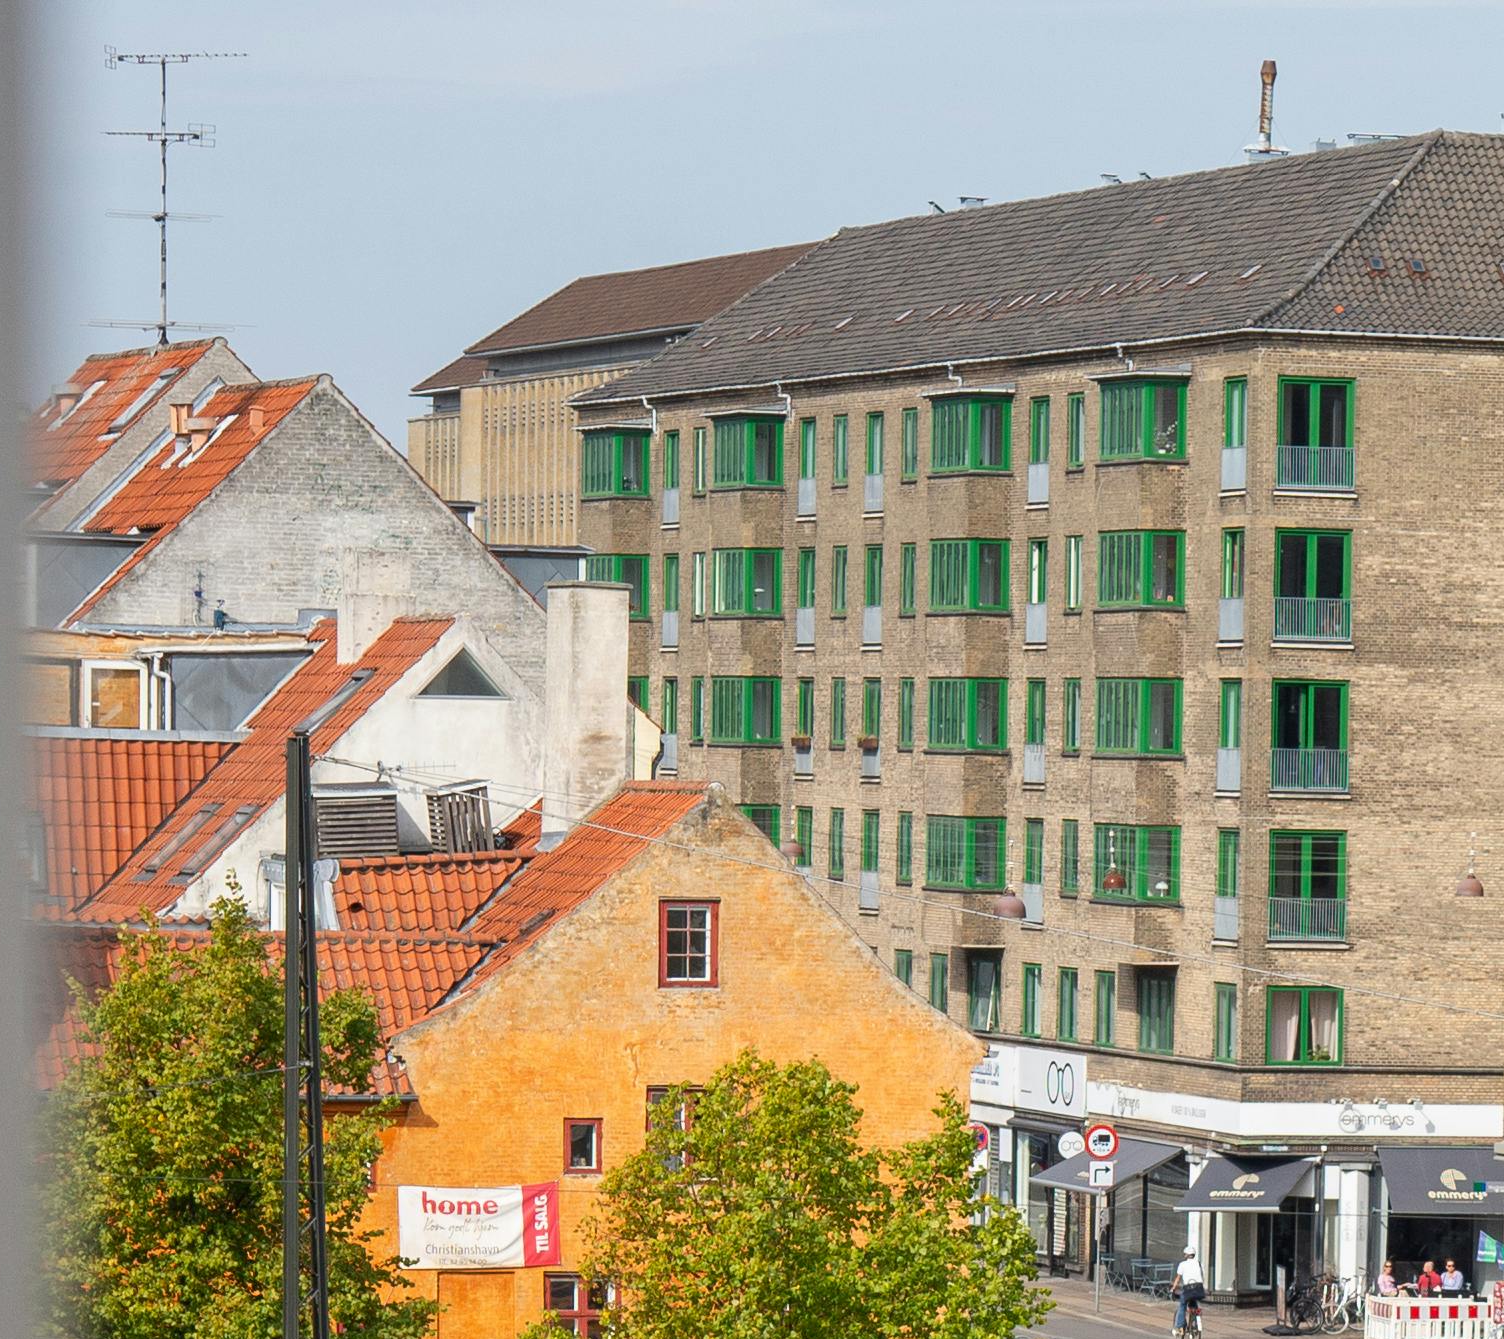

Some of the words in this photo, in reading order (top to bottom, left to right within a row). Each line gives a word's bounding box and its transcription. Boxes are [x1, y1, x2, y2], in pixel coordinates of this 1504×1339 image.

[1342, 1114, 1415, 1126] emmerys
[421, 1191, 499, 1215] home
[534, 1194, 549, 1231] SALG
[425, 1244, 500, 1256] Christianshavn
[535, 1232, 549, 1254] TIL
